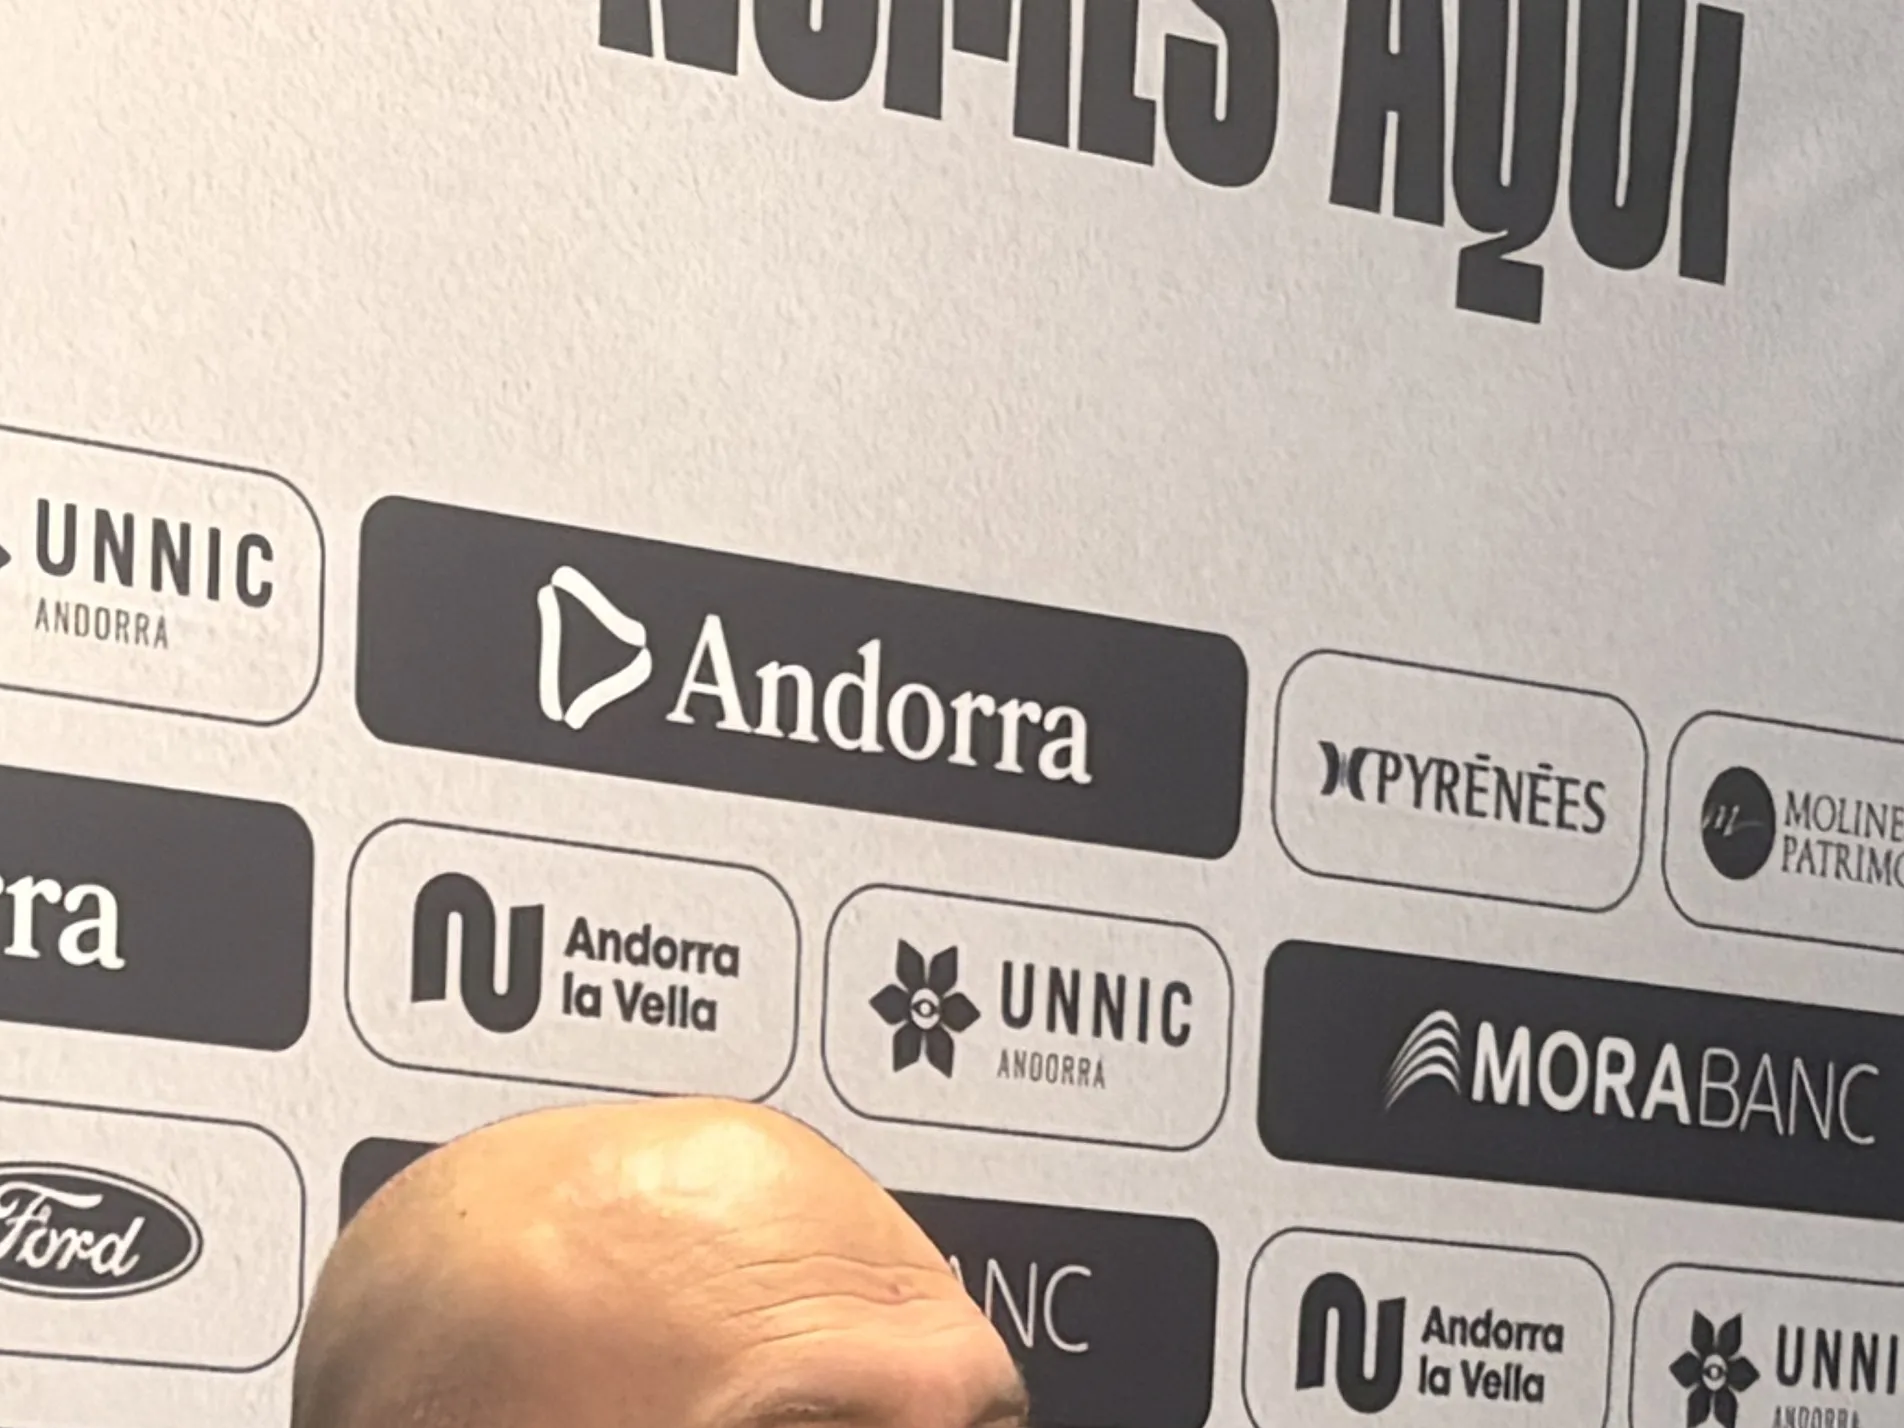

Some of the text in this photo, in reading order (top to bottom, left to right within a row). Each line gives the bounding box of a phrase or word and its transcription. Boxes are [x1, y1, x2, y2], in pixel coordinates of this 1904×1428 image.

[37, 499, 273, 607] UNNIC
[35, 598, 168, 649] ANDORRA
[667, 615, 1091, 783] Andorra
[564, 917, 739, 977] Andorra
[563, 972, 717, 1031] la Vella
[1002, 961, 1192, 1047] UNNIC
[997, 1049, 1105, 1088] ANDORRA
[1472, 1022, 1878, 1143] MORABANC
[1422, 1306, 1564, 1353] Andorra
[1419, 1355, 1544, 1403] la Vella
